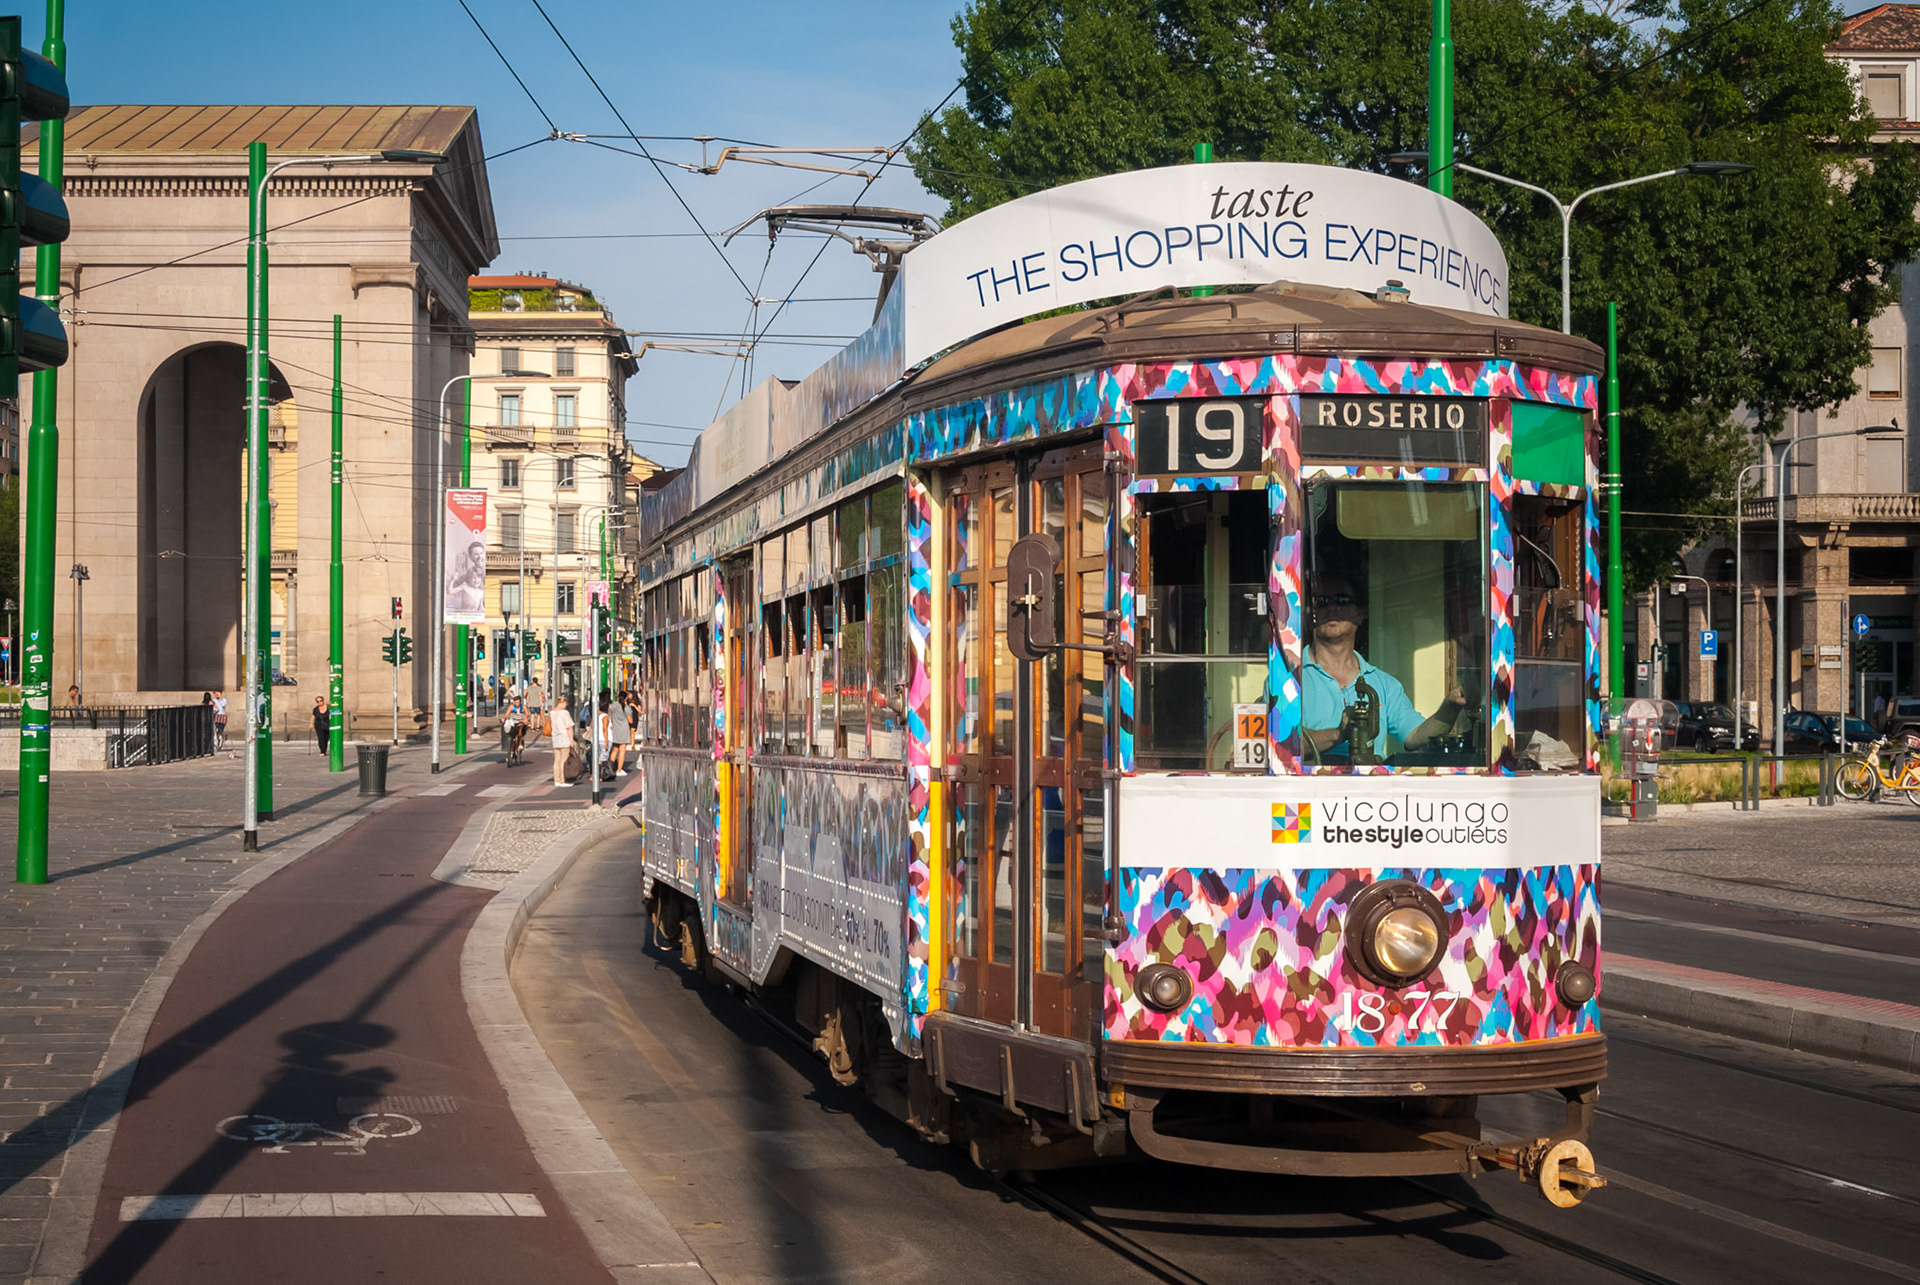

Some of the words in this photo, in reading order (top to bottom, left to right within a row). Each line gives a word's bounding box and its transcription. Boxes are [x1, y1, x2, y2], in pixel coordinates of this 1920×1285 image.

[1211, 184, 1314, 219] taste
[966, 252, 1051, 308] THE
[1059, 221, 1308, 282] SHOPPING
[1325, 223, 1501, 317] EXPERIENCE
[1318, 401, 1466, 429] ROSERIO
[1165, 401, 1245, 471] 19
[1703, 632, 1714, 644] P
[1241, 716, 1265, 738] 12
[1241, 742, 1265, 764] 19
[1322, 794, 1509, 828] vicolungo
[874, 918, 890, 959] 70%
